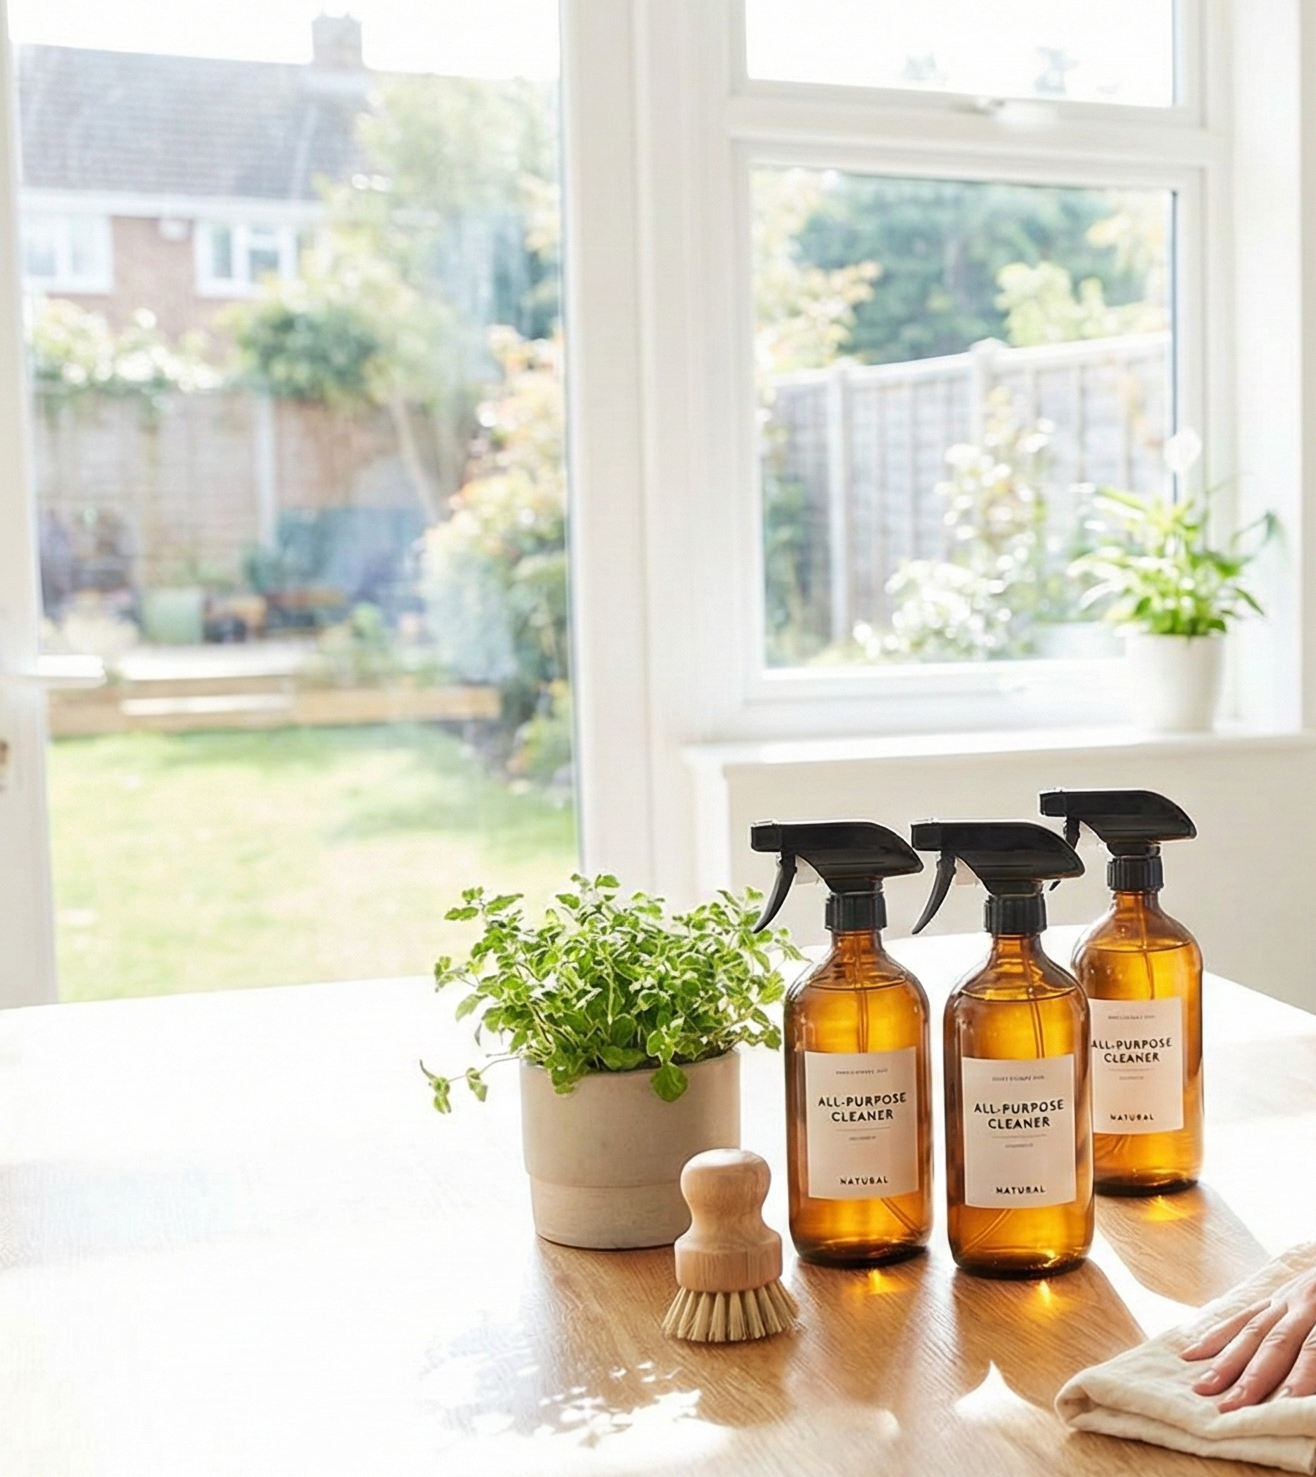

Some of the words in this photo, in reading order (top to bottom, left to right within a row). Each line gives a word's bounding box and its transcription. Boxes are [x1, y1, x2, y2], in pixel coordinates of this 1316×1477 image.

[1103, 1052, 1161, 1063] CLEANER
[818, 1092, 907, 1107] ALL-PURPOSE
[974, 1099, 1065, 1114] ALL-PURPOSE
[831, 1109, 894, 1122] CLEANER
[987, 1116, 1051, 1130] CLEANER
[995, 1185, 1046, 1195] NATURAL
